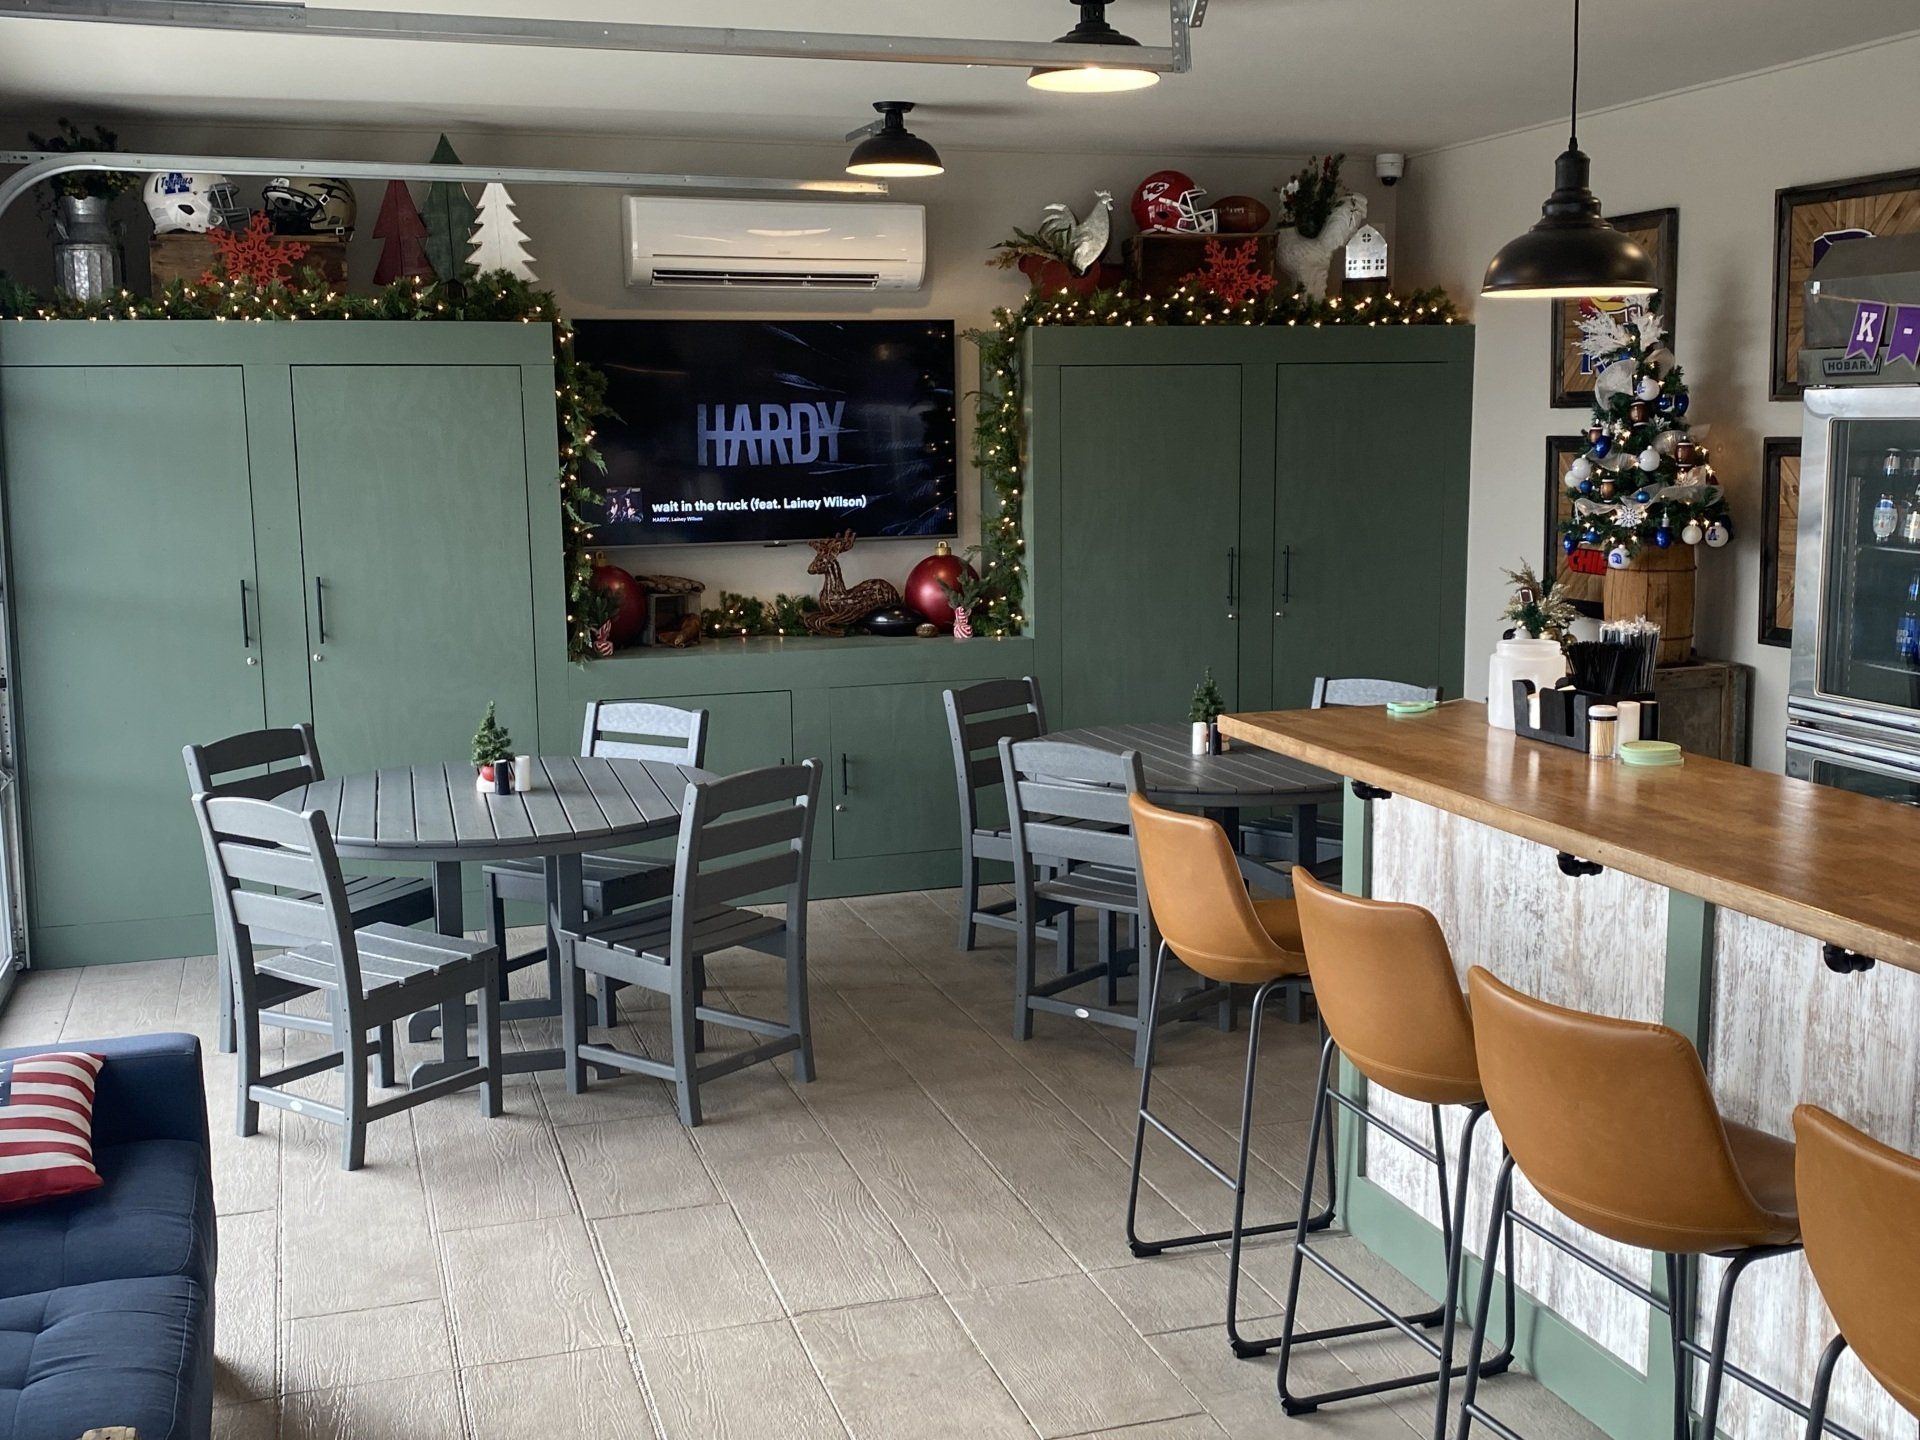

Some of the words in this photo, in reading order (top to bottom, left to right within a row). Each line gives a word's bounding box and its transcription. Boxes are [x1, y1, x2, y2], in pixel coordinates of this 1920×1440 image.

[697, 401, 846, 467] HARDY
[652, 500, 679, 512] wait
[681, 500, 693, 512] in
[694, 499, 715, 511] the
[716, 498, 748, 511] truck
[750, 497, 781, 511] (feat.
[783, 497, 821, 510] Lainey
[823, 495, 866, 508] Wilson)
